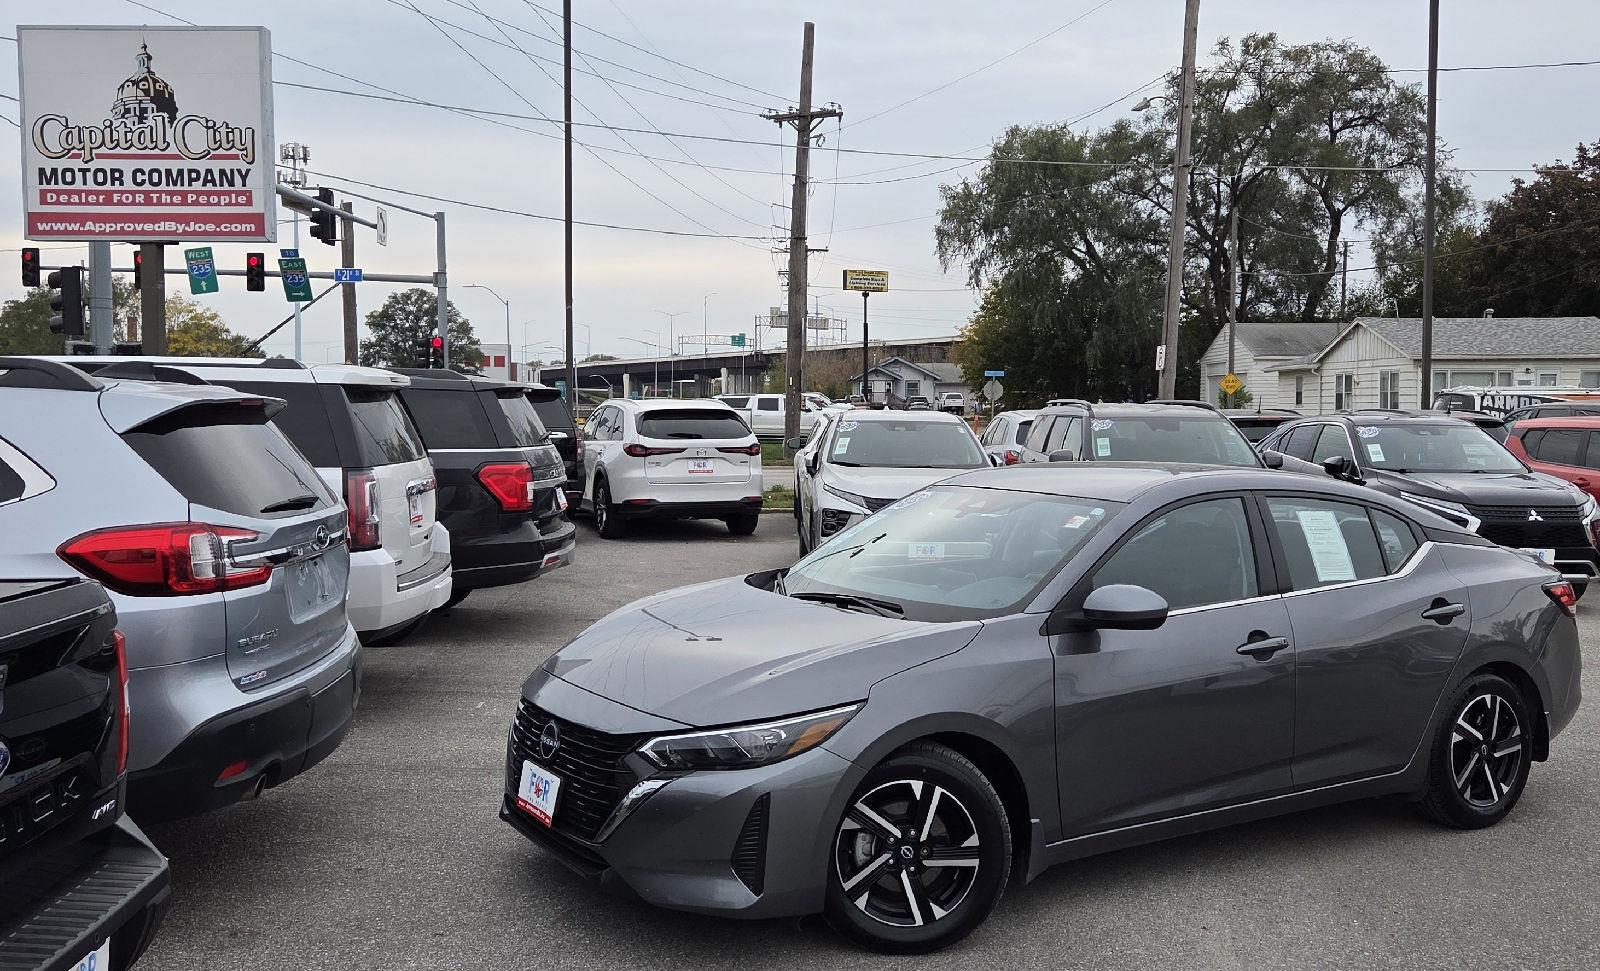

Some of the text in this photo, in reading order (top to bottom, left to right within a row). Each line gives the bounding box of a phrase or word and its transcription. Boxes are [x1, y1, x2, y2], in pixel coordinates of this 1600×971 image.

[32, 113, 255, 164] Capital City
[38, 167, 251, 187] MOTOR COMPANY
[47, 192, 247, 204] Dealer FOR The People
[37, 221, 255, 233] www.ApprovedByJoe.com
[187, 250, 209, 259] WEST
[192, 263, 211, 275] 235
[282, 260, 304, 268] EAST
[286, 275, 305, 283] 235
